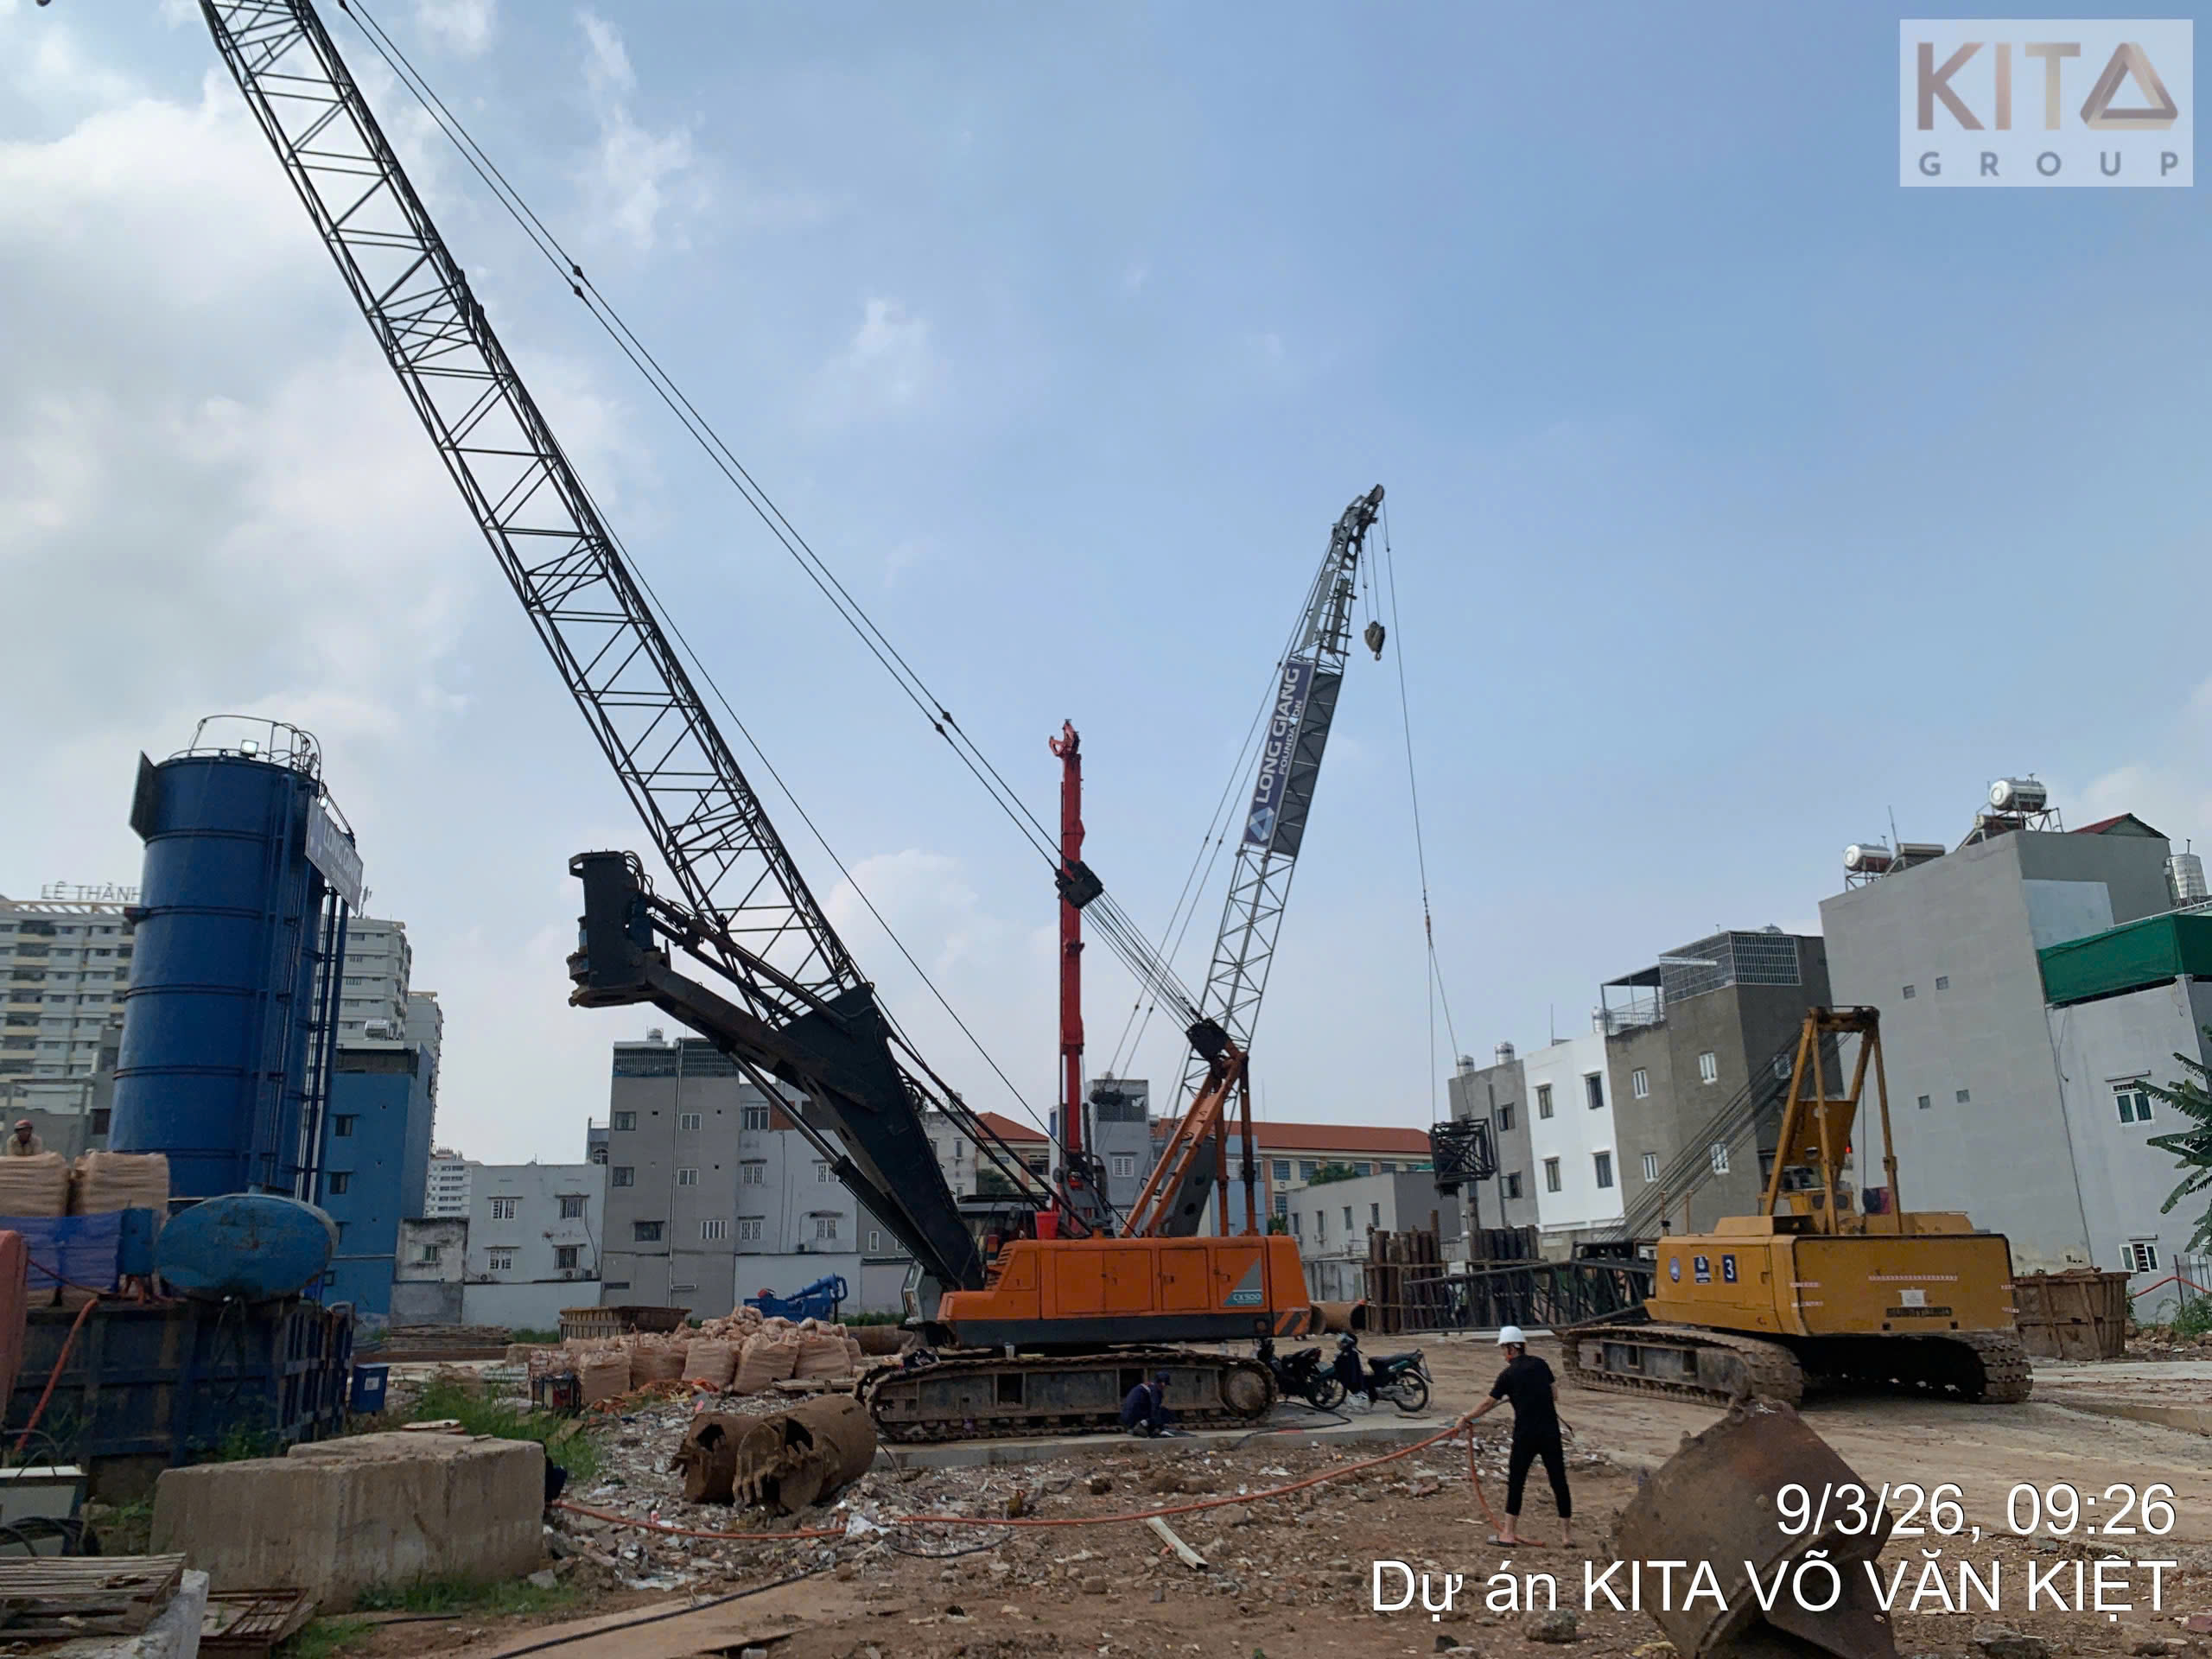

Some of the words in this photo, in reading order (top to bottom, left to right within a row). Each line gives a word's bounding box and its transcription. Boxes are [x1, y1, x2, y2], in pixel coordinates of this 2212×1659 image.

[1255, 741, 1282, 804] LONG
[1272, 668, 1300, 738] GIANG
[1279, 700, 1303, 775] FOUNDAON
[41, 880, 65, 899] LÊ
[1725, 1258, 1734, 1279] 3
